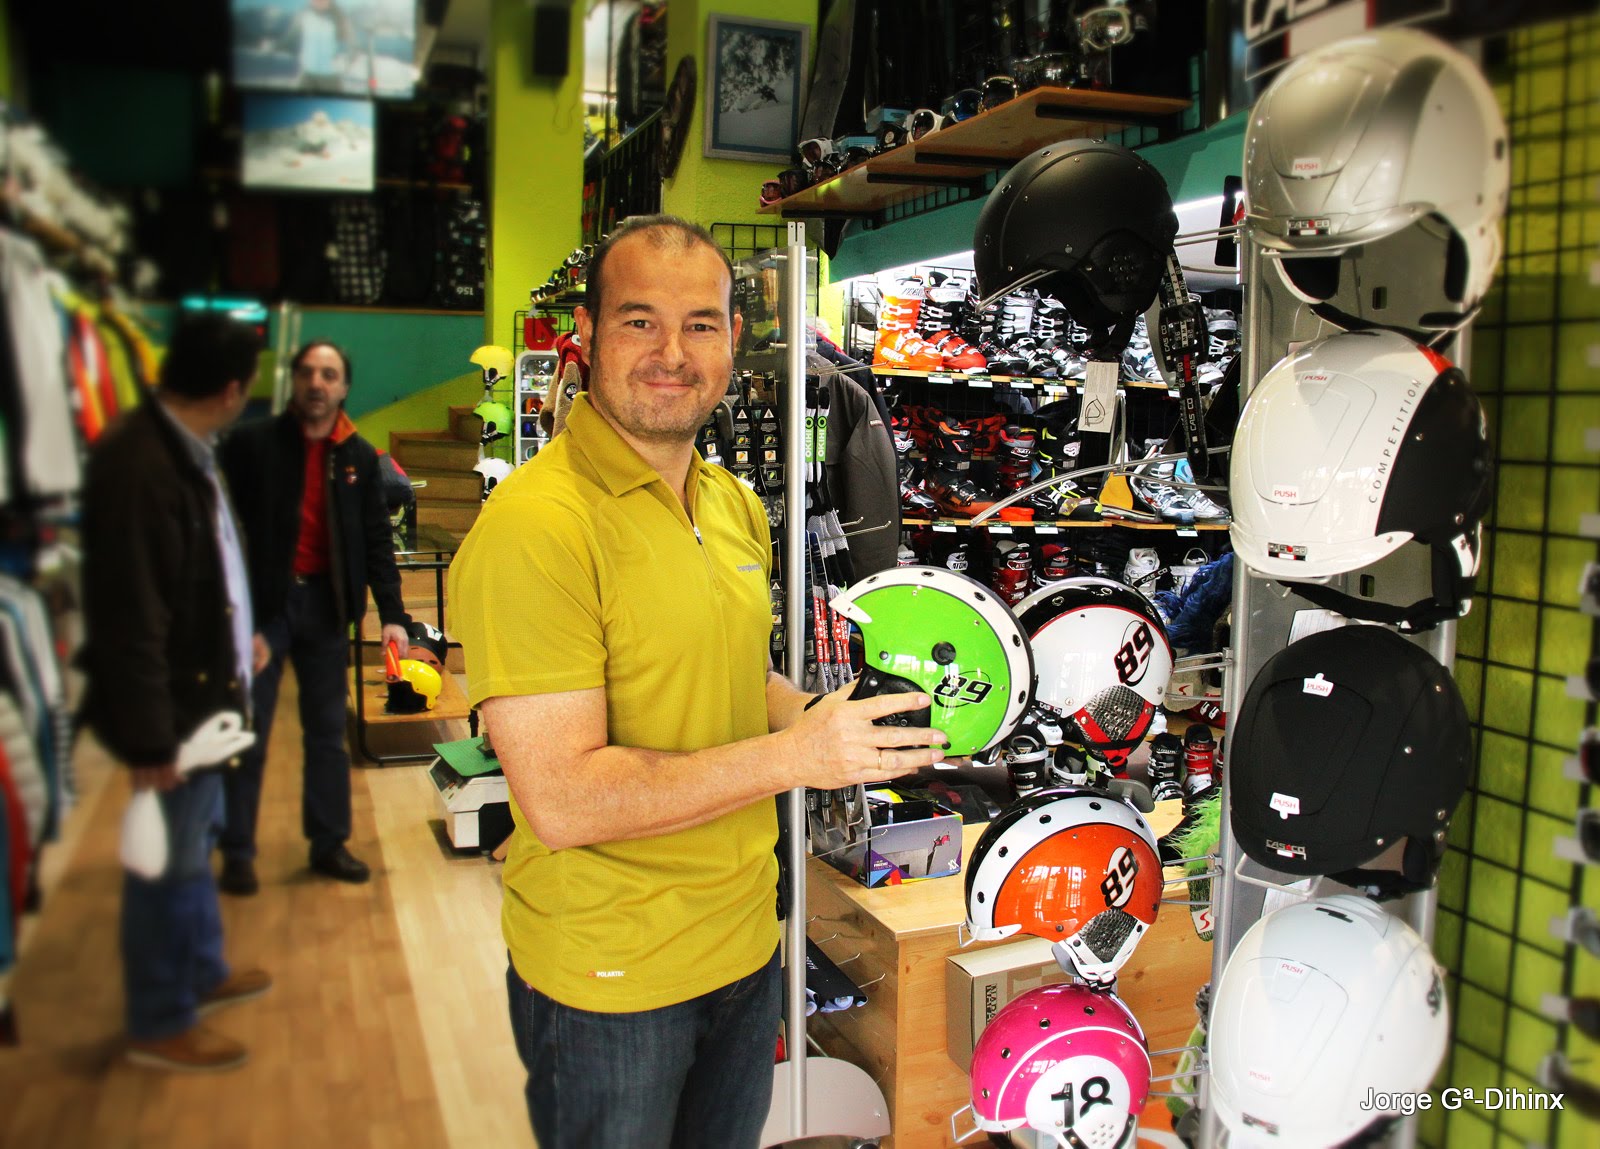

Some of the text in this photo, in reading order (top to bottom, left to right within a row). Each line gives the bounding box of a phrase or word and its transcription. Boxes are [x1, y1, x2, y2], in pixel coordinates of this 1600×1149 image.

[1294, 162, 1320, 171] PUSH
[1304, 374, 1329, 382] PUSH
[1368, 380, 1422, 503] COMPETITION
[1273, 488, 1298, 498] PUSH
[1113, 621, 1155, 684] 89
[933, 674, 993, 704] 89
[1306, 682, 1330, 693] PUSH
[1273, 797, 1297, 809] PUSH
[1100, 847, 1139, 908] 89
[1281, 962, 1304, 975] PUSH
[1051, 1076, 1114, 1128] 18
